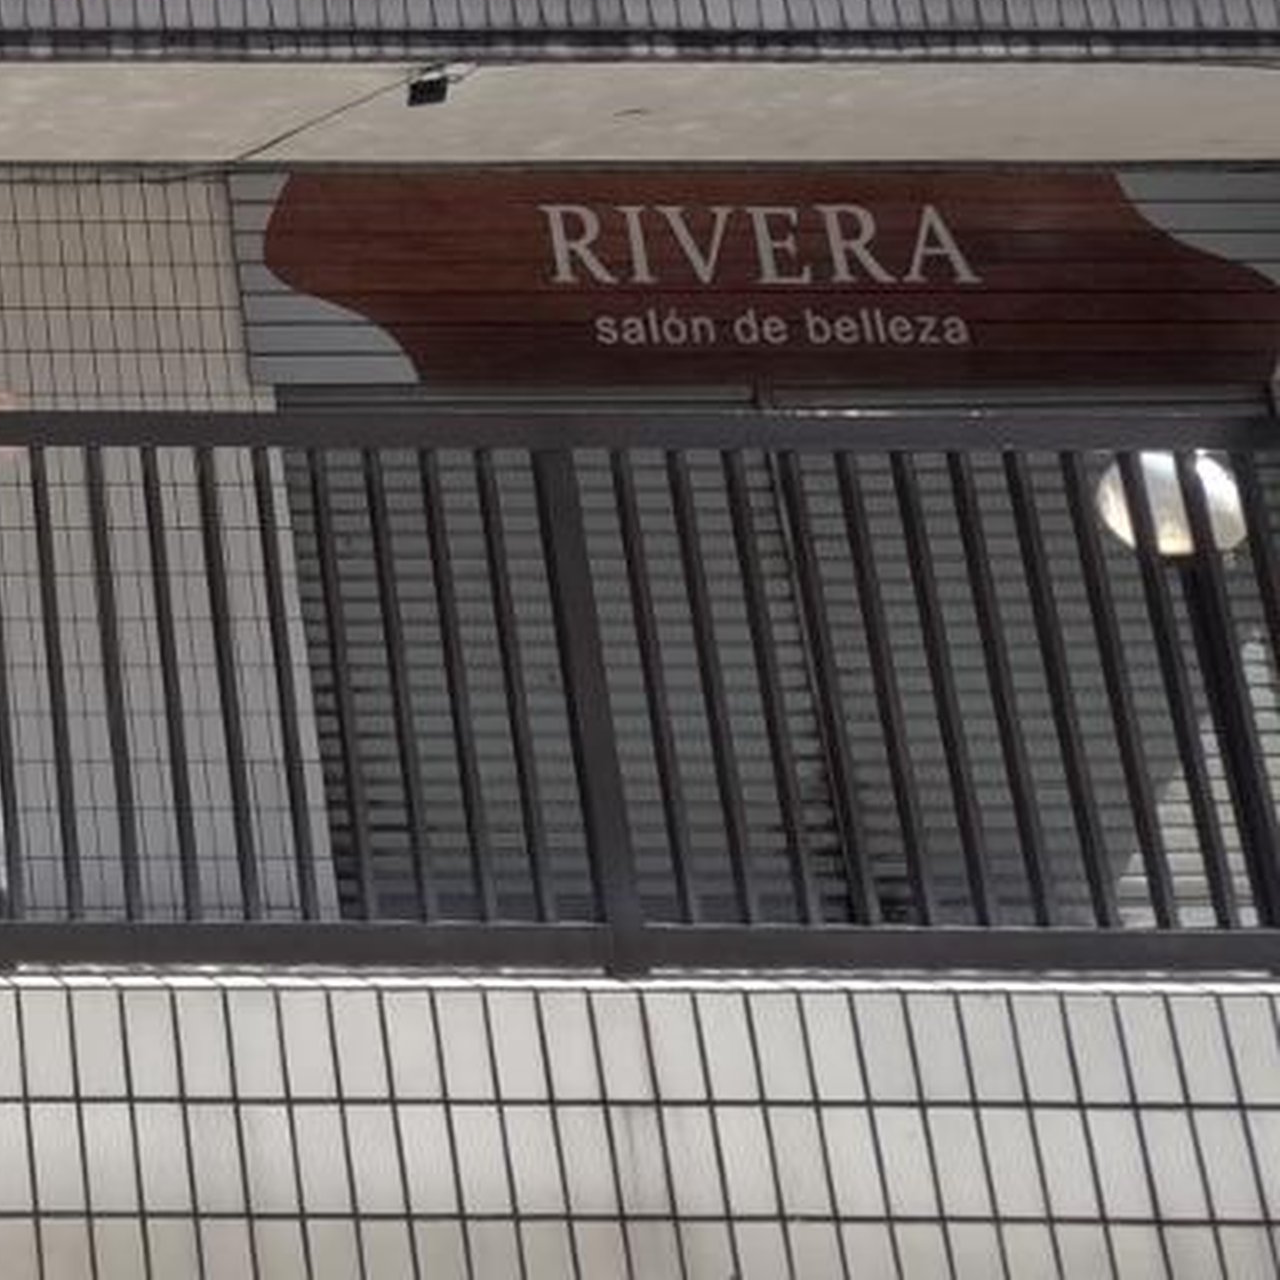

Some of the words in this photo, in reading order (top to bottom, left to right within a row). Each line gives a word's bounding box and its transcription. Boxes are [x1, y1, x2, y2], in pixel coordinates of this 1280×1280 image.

[540, 204, 983, 284] RIVERA
[595, 308, 717, 345] salón
[733, 308, 789, 345] de
[805, 308, 971, 345] belleza
